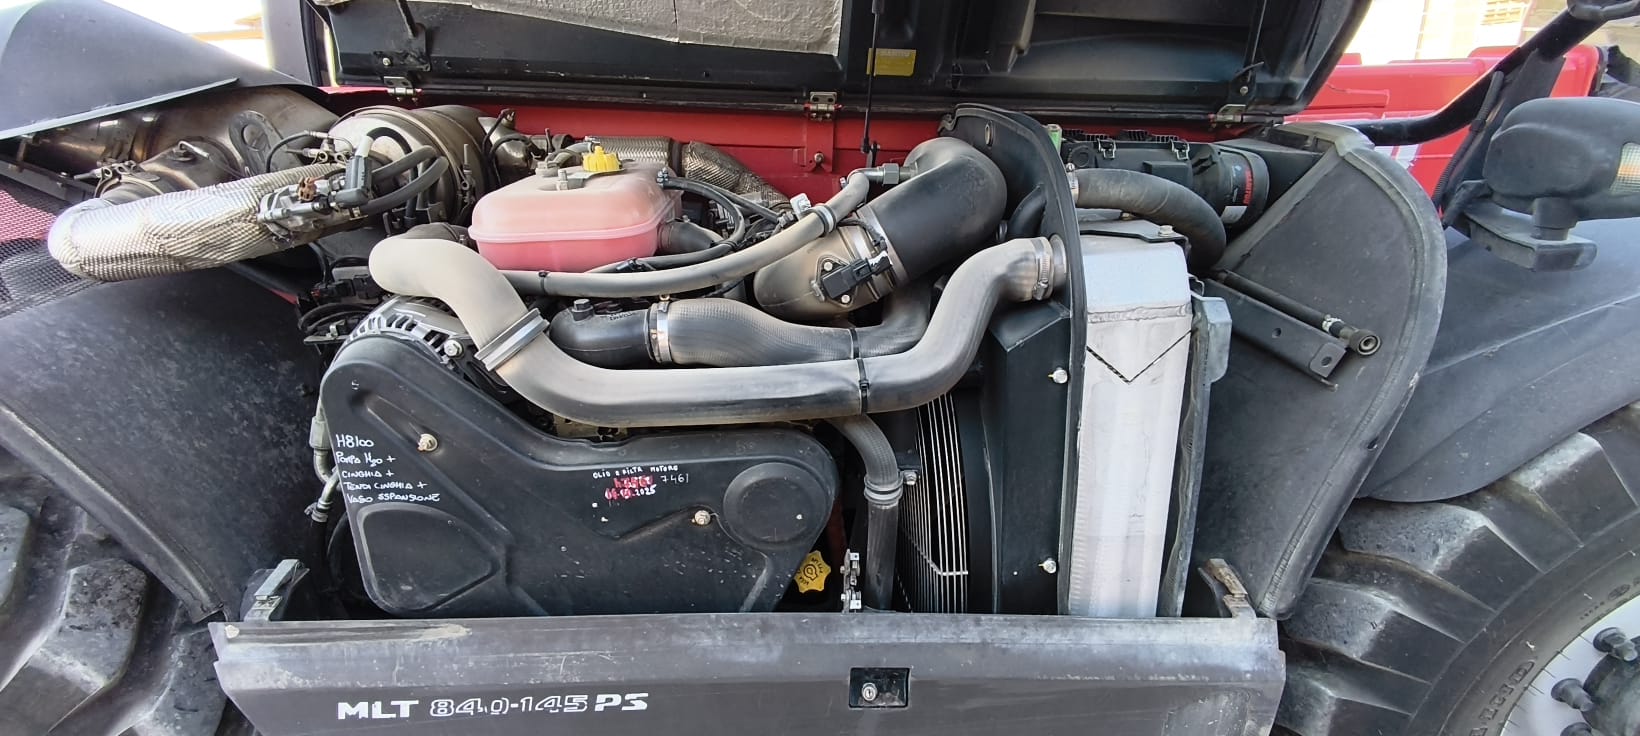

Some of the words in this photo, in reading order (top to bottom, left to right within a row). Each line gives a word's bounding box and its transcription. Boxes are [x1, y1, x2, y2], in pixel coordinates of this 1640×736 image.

[341, 470, 382, 478] CINGHIA
[374, 482, 413, 490] CINGHIA
[337, 700, 419, 720] MLT
[594, 692, 649, 712] PS
